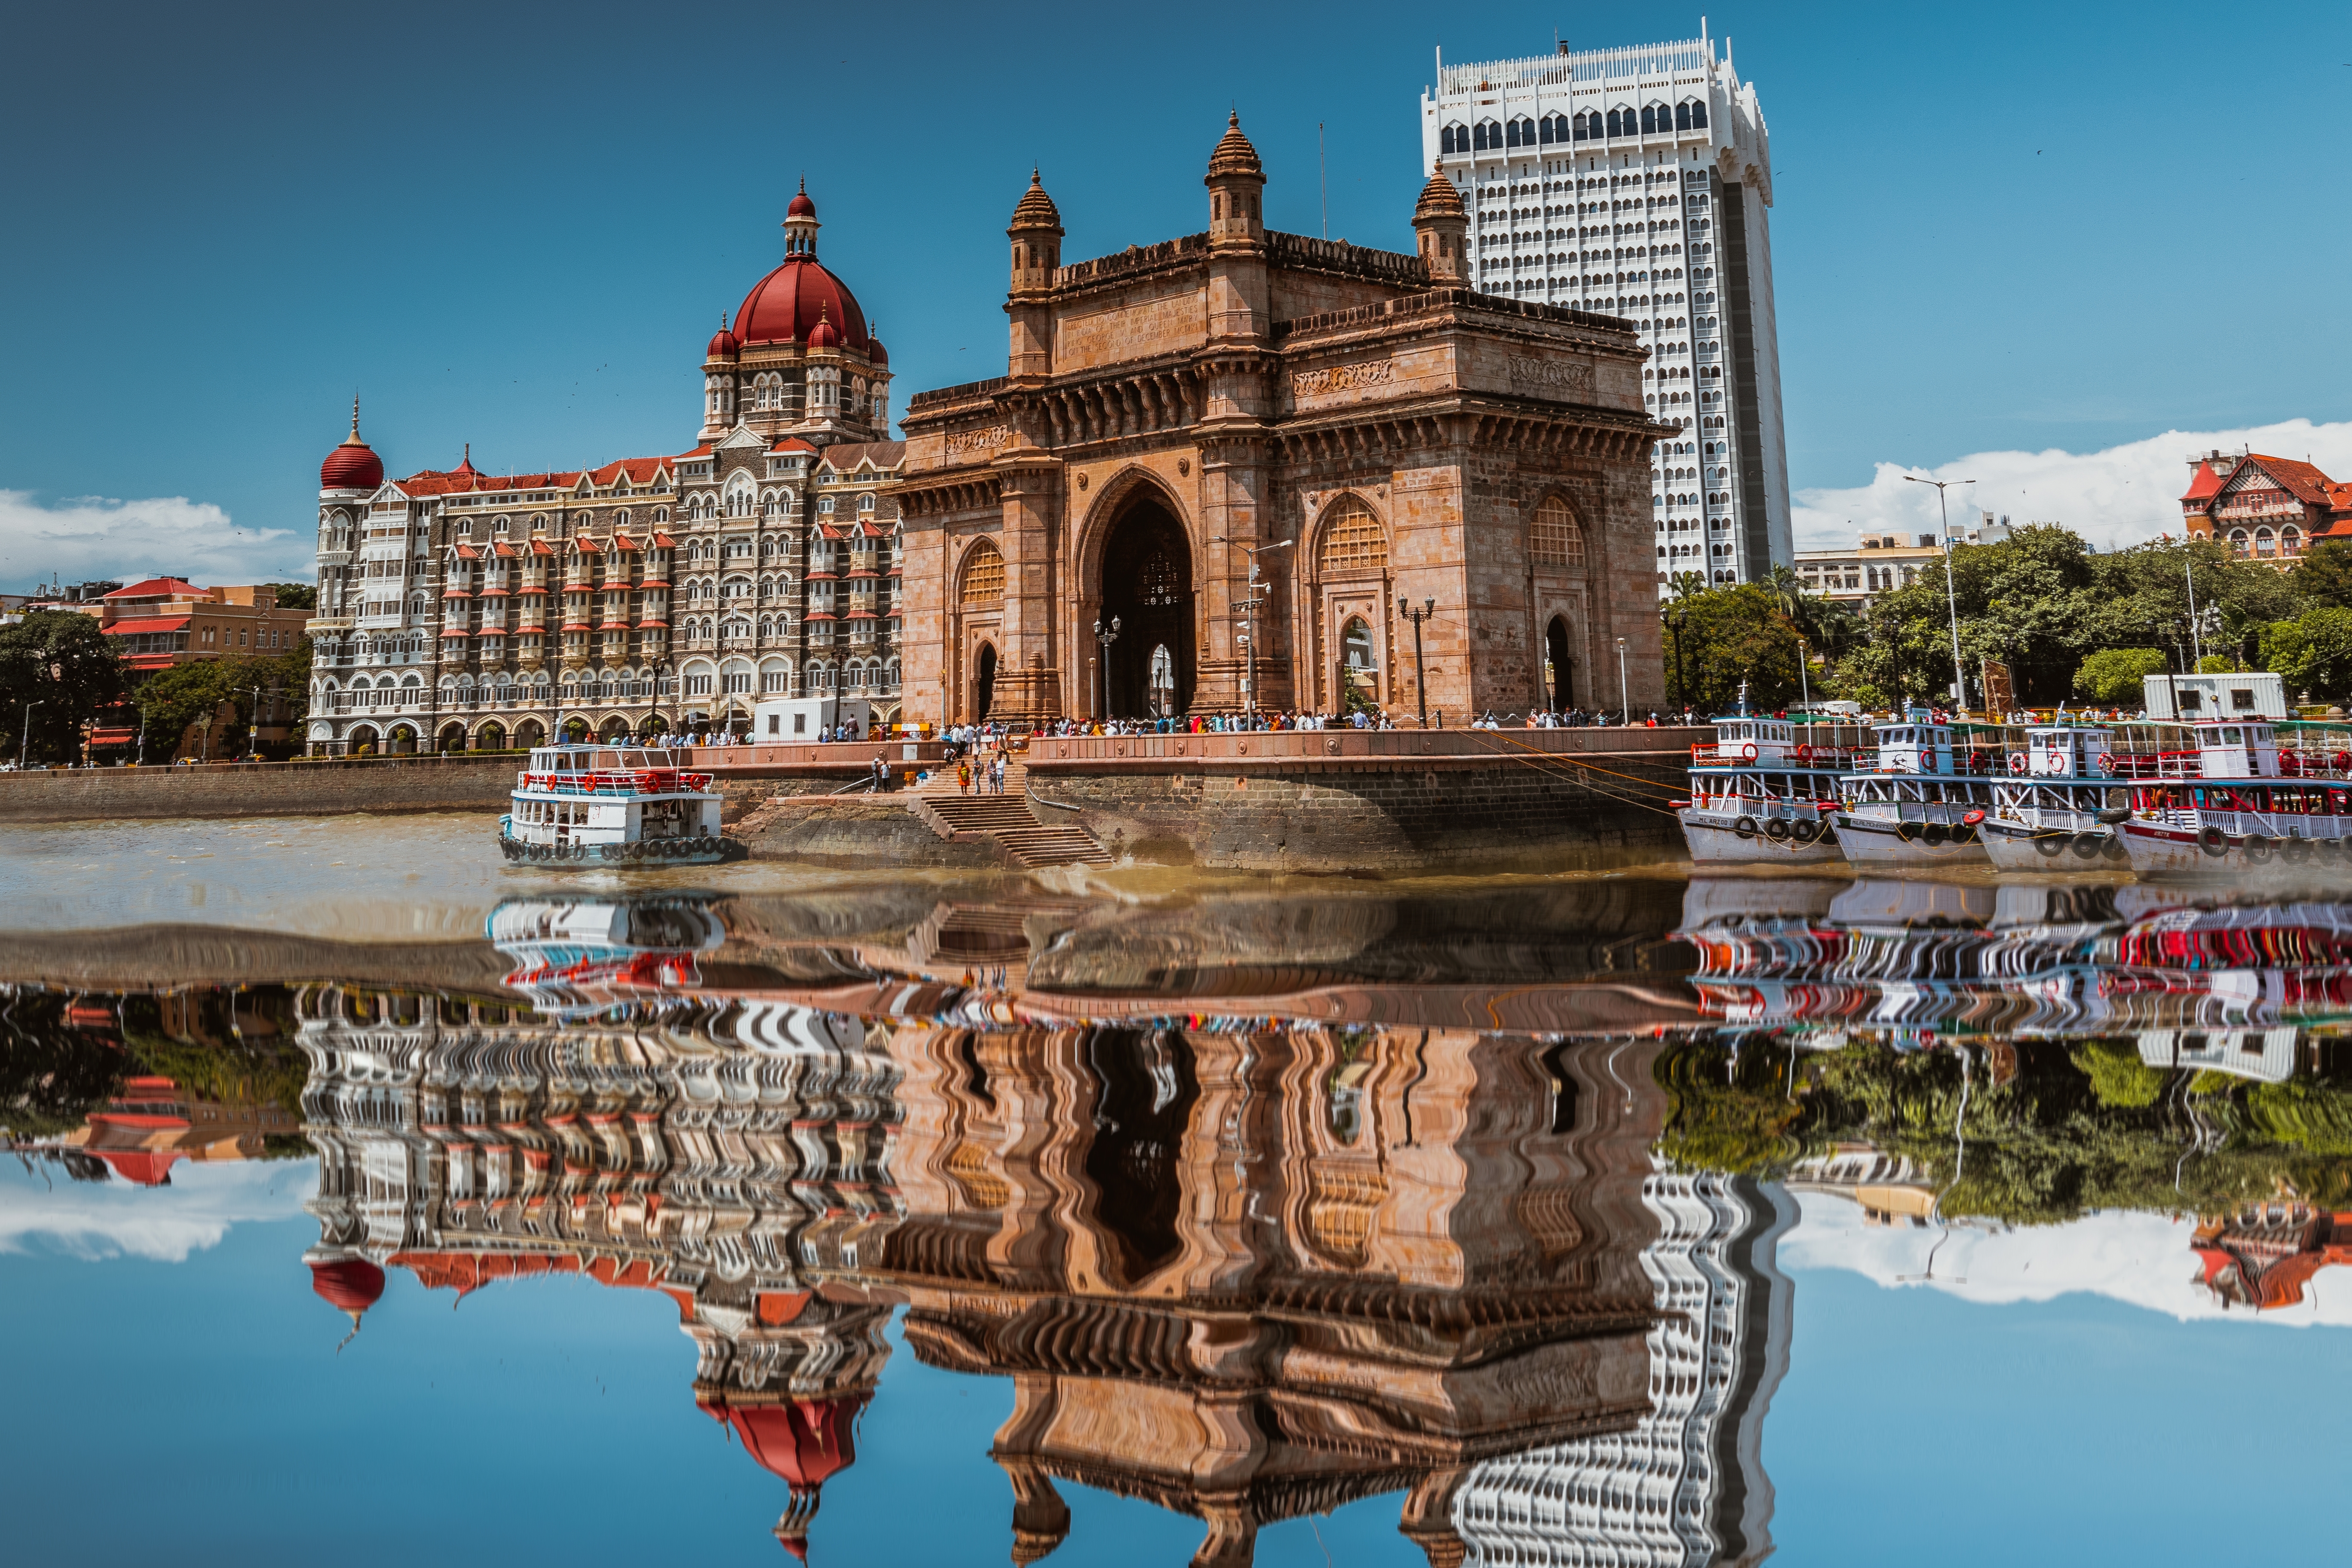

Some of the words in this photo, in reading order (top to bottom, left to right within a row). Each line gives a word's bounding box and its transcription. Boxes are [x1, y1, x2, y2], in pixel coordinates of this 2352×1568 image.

[1067, 318, 1093, 330] ERECTED
[1108, 305, 1154, 321] COMMEMORATE
[1157, 302, 1168, 311] THE
[1172, 296, 1197, 308] LANDING
[1077, 328, 1091, 337] INDIA
[1096, 325, 1104, 333] OF
[1110, 320, 1125, 330] THEIR
[1130, 313, 1158, 325] IMPERIAL
[1163, 305, 1197, 318] MAJESTIES
[1068, 338, 1082, 347] KING
[1087, 332, 1114, 343] GEORGE
[1130, 325, 1143, 335] AND
[1149, 319, 1173, 331] QUEEN
[1178, 314, 1197, 325] MARY
[1069, 348, 1078, 356] ON
[1081, 345, 1091, 353] THE
[1096, 340, 1121, 351] SECOND
[1125, 336, 1133, 344] OF
[1137, 329, 1170, 343] DECEMBER
[1174, 323, 1197, 335] MCMXI
